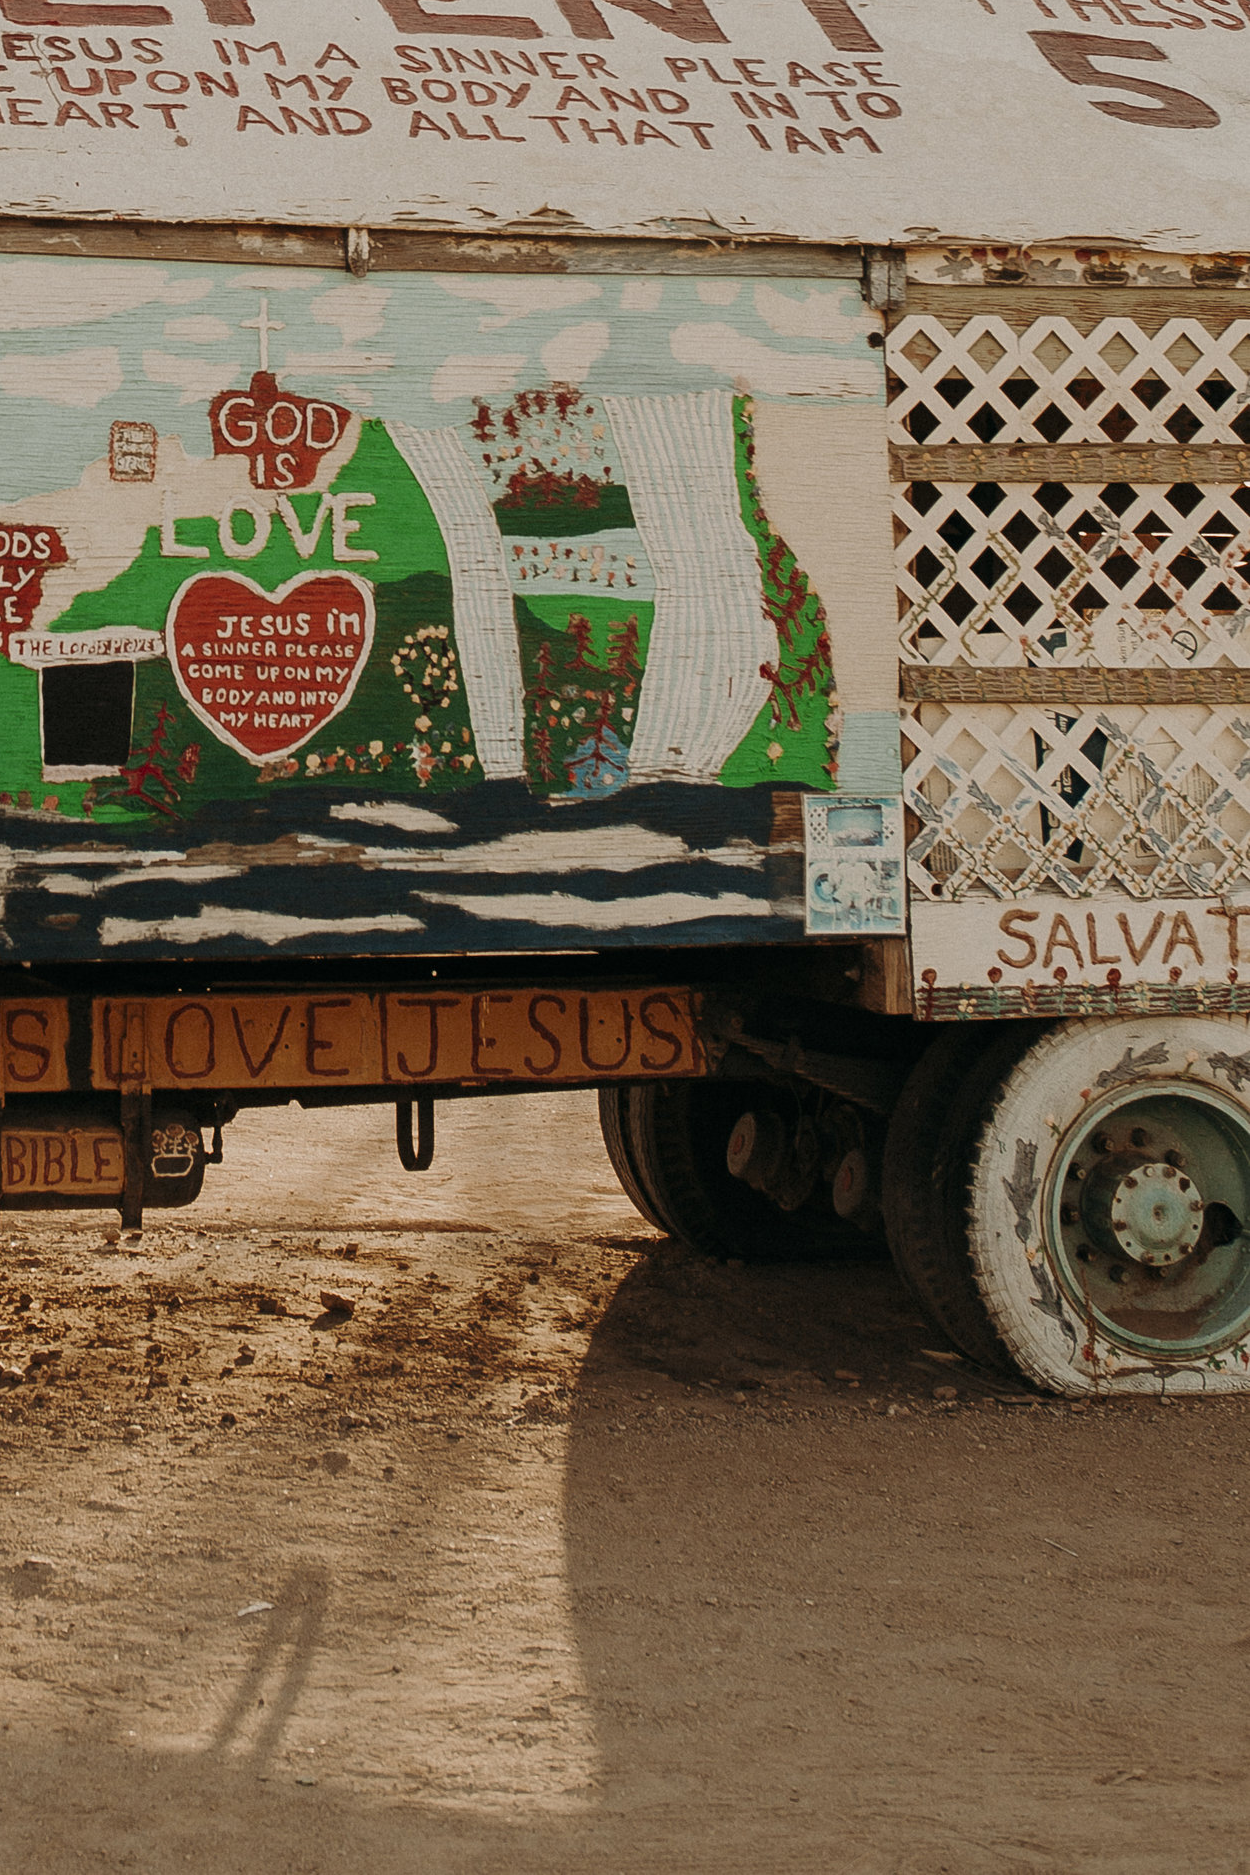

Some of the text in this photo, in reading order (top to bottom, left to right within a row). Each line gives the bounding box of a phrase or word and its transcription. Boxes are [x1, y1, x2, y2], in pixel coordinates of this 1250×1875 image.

[314, 43, 361, 69] A
[394, 44, 619, 79] SINNER
[664, 56, 901, 88] PLEASE
[1027, 29, 1221, 130] 5
[52, 67, 240, 98] UPON
[265, 72, 353, 101] MY
[381, 76, 531, 108] BODY
[556, 85, 690, 114] AND
[236, 105, 372, 137] AND
[409, 110, 527, 143] ALL
[528, 115, 715, 150] THAT
[746, 123, 772, 151] I
[785, 125, 883, 154] AM
[218, 397, 339, 450] GOD
[255, 452, 297, 487] IS
[160, 490, 380, 562] LOVE
[216, 612, 311, 638] JESUS
[15, 639, 52, 657] THE
[180, 641, 355, 658] A SINNER PLEASE
[187, 663, 349, 684] COME UPON MY
[201, 687, 339, 707] BODY AND INTO
[219, 711, 315, 728] MY HEART
[102, 998, 351, 1080] LOVE
[397, 992, 682, 1077] JESUS
[6, 1135, 120, 1187] BIBLE
